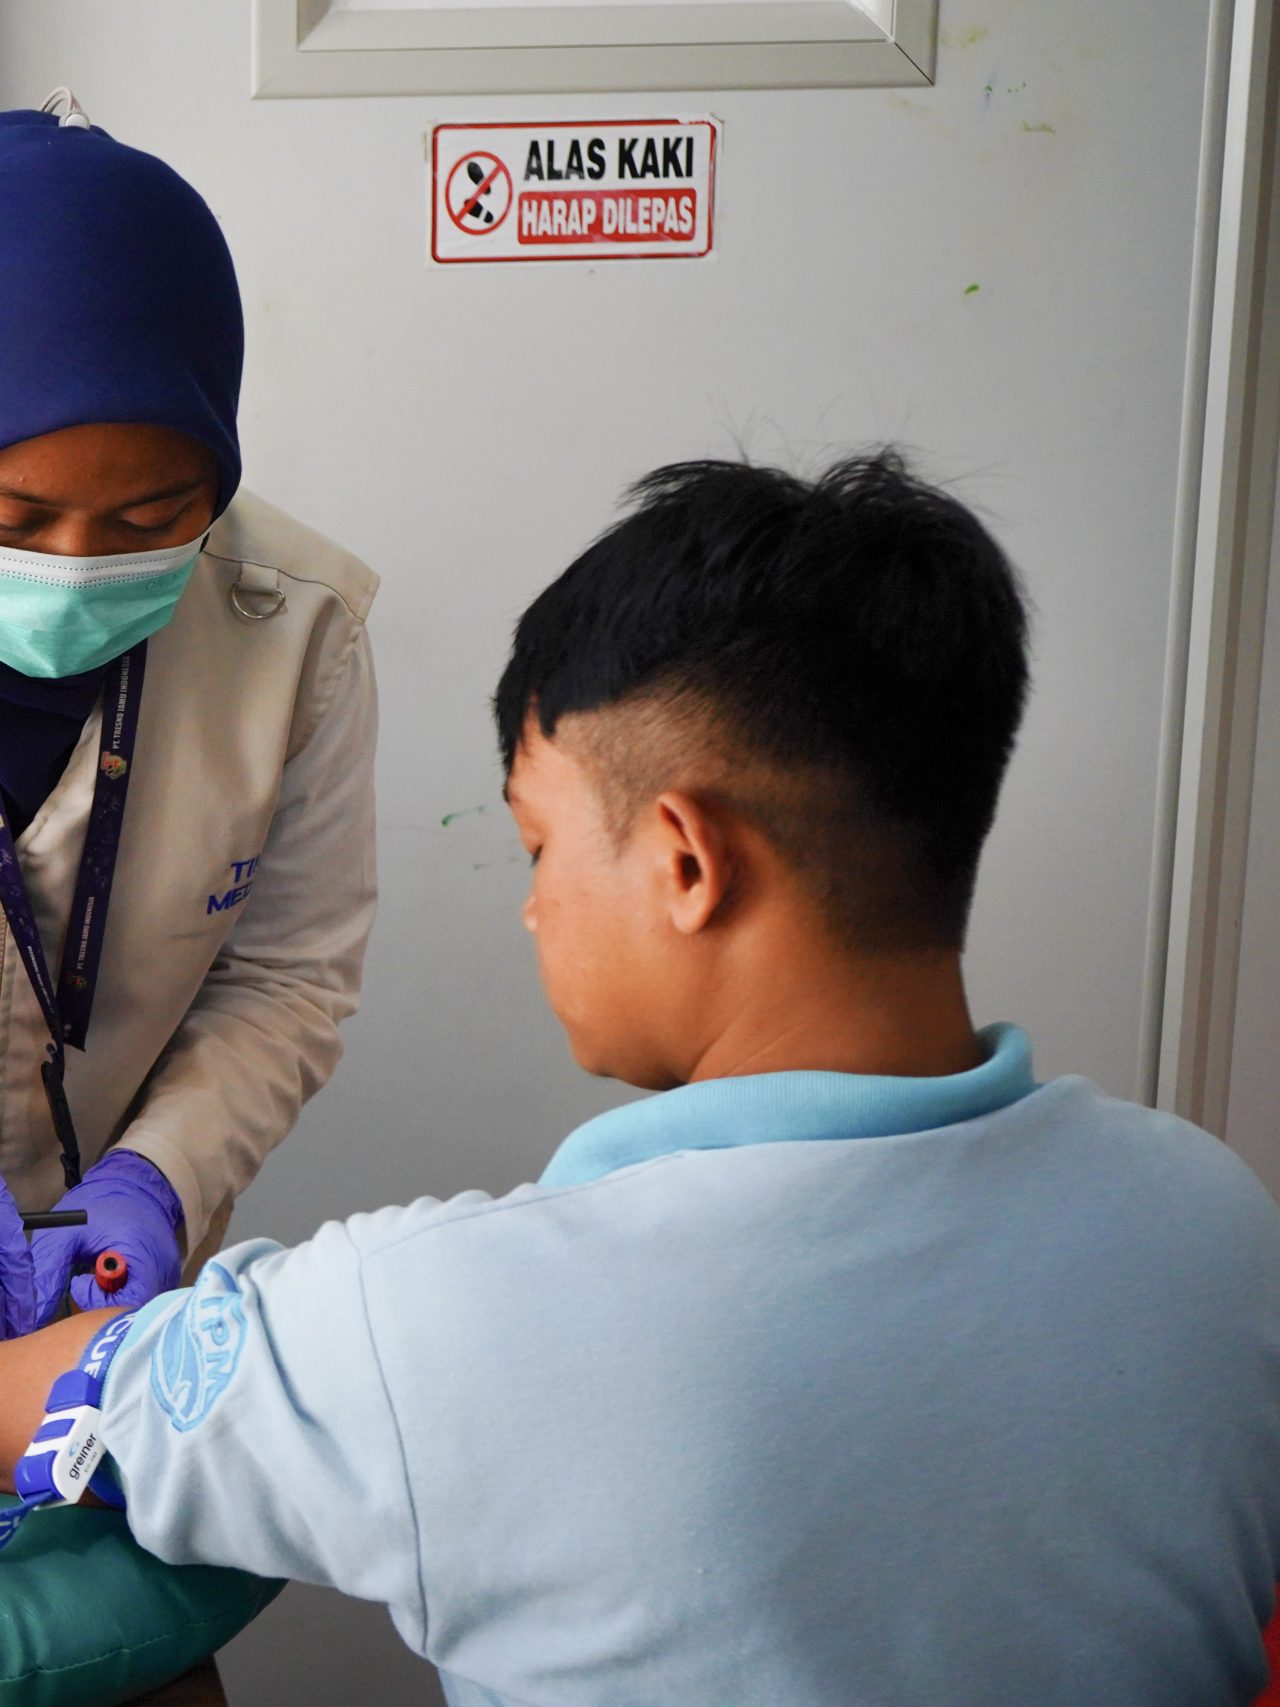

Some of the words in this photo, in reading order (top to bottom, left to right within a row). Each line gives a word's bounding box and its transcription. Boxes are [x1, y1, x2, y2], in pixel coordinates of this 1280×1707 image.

[523, 138, 606, 181] ALAS
[618, 137, 694, 179] KAKI
[521, 199, 596, 236] HARAP
[603, 196, 693, 235] DILEPAS
[114, 713, 124, 738] TRESNO
[69, 1432, 97, 1480] greiner
